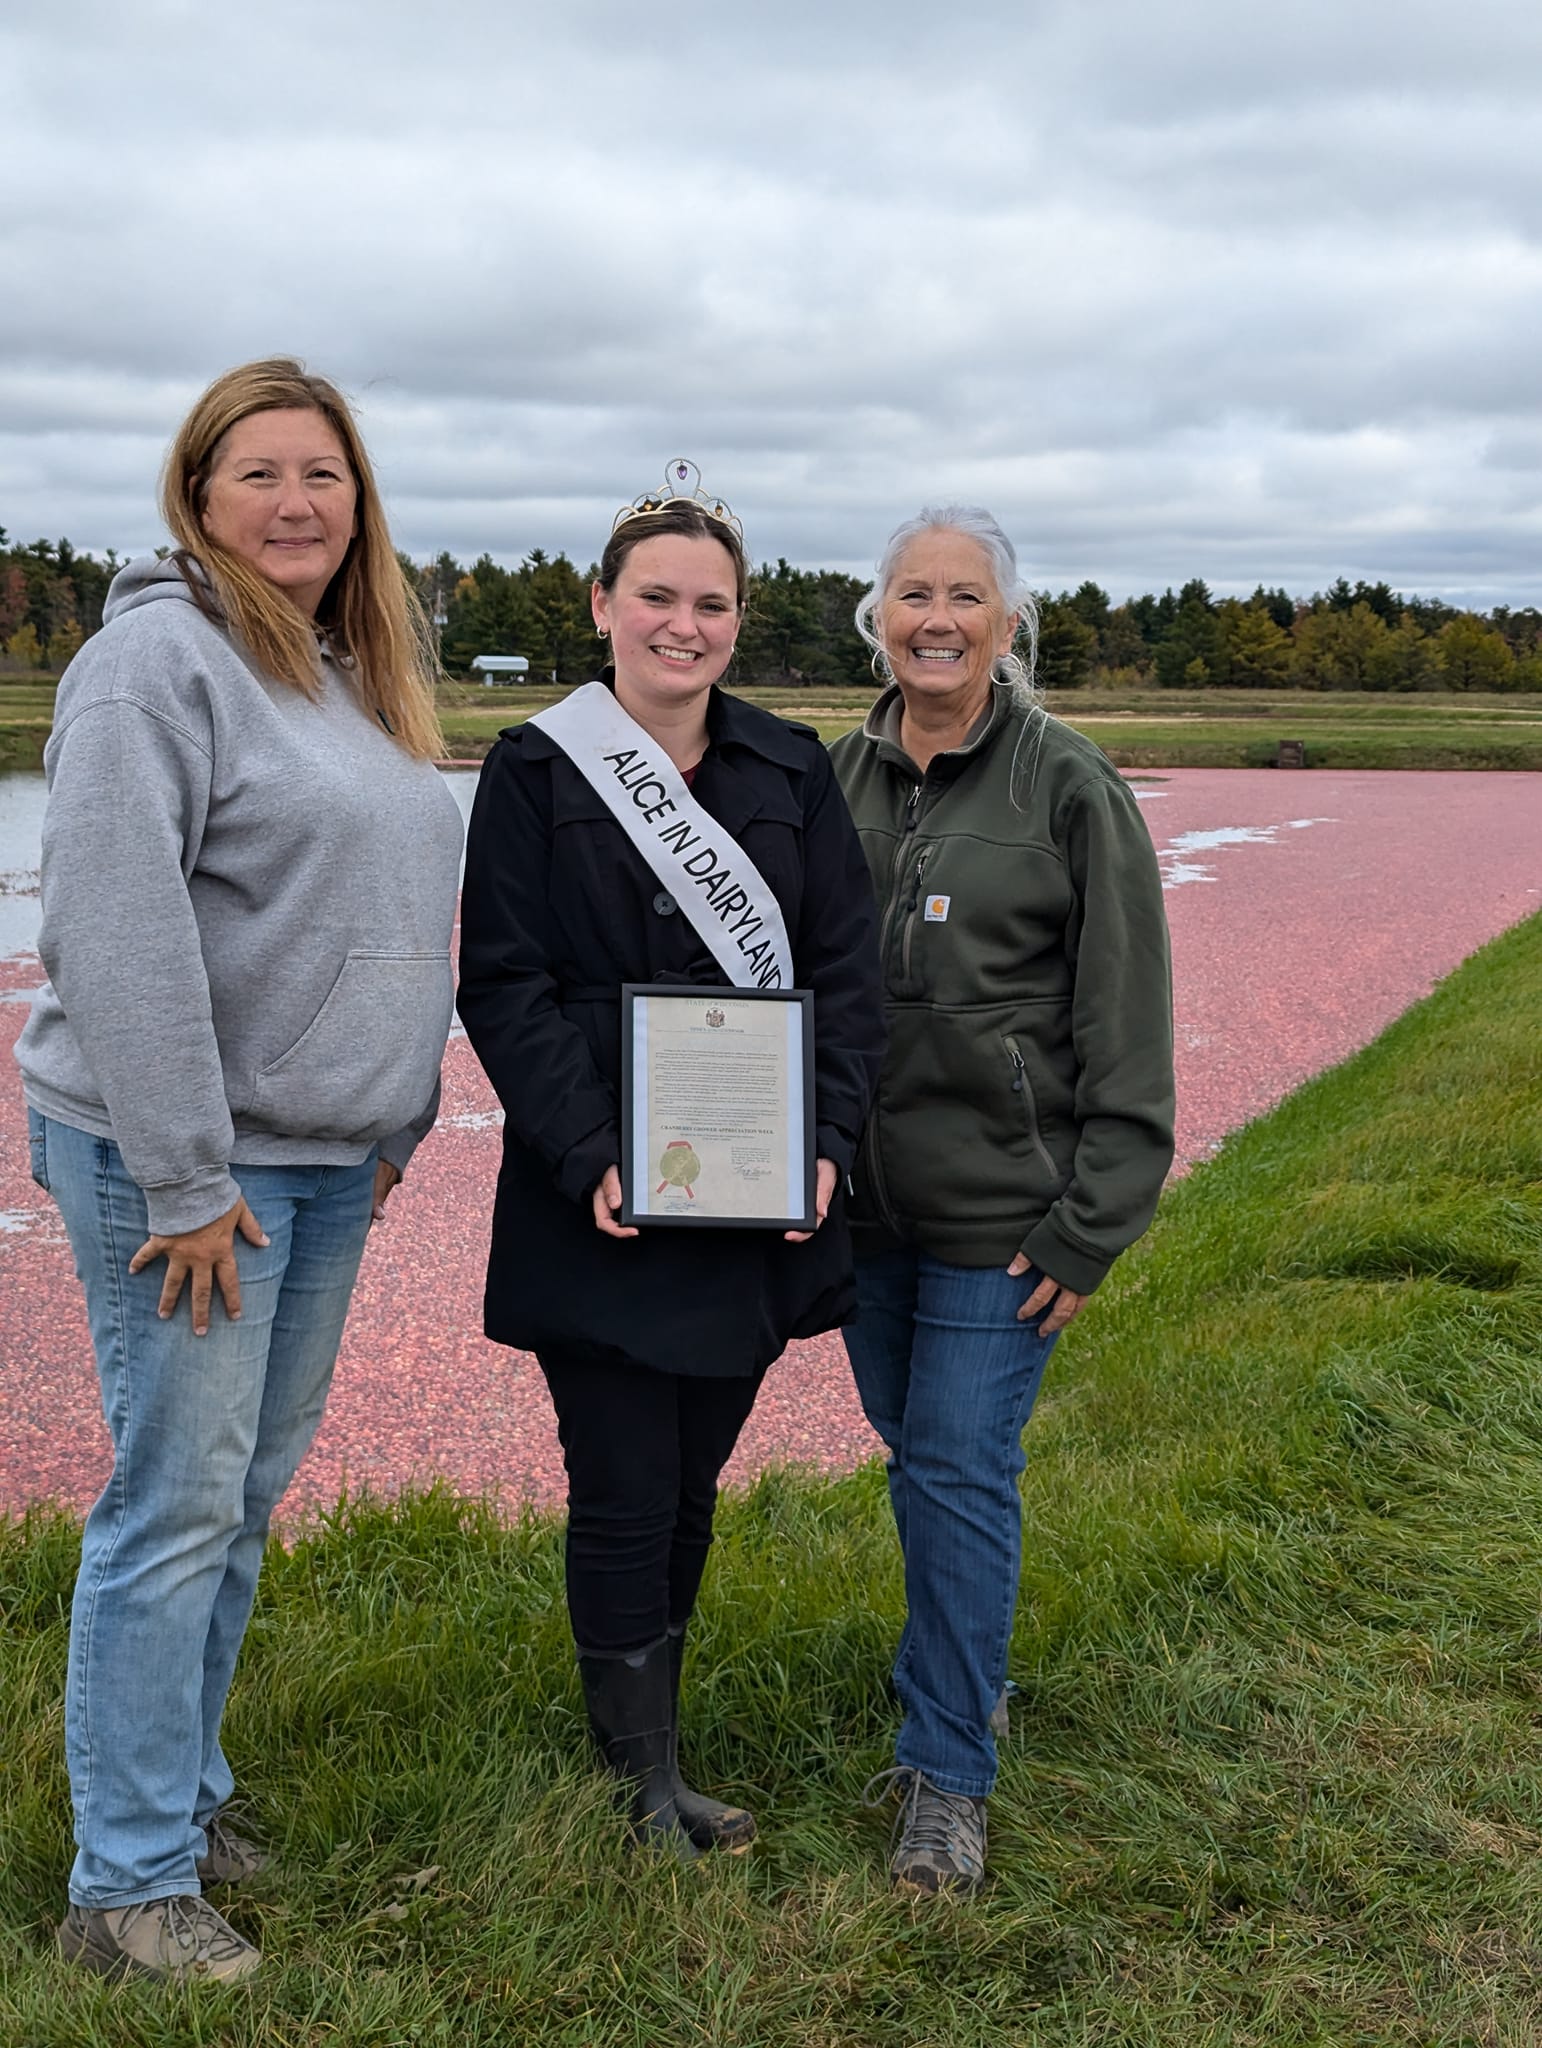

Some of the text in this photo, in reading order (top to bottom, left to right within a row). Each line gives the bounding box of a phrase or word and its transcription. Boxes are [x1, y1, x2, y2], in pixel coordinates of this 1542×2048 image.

[602, 749, 677, 825] ALICE
[658, 820, 702, 855] IN
[682, 847, 782, 990] DAIRYLAND
